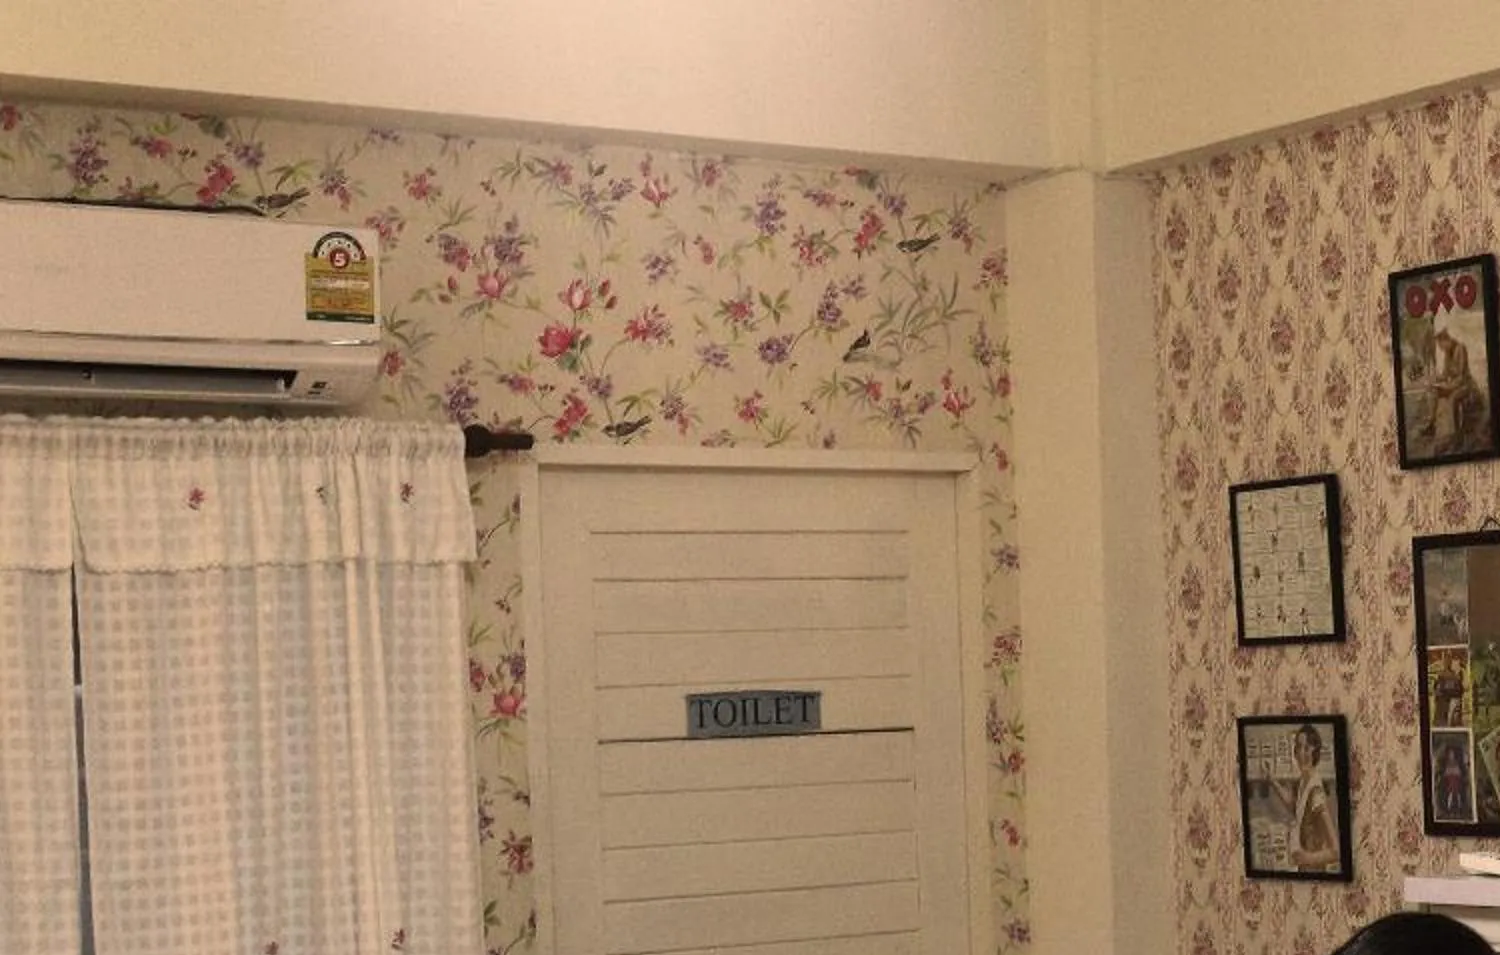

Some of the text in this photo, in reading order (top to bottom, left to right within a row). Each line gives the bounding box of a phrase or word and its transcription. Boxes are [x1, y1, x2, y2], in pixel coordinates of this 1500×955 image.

[335, 253, 347, 267] 5
[1406, 276, 1477, 317] OXO
[692, 695, 816, 728] TOILET
